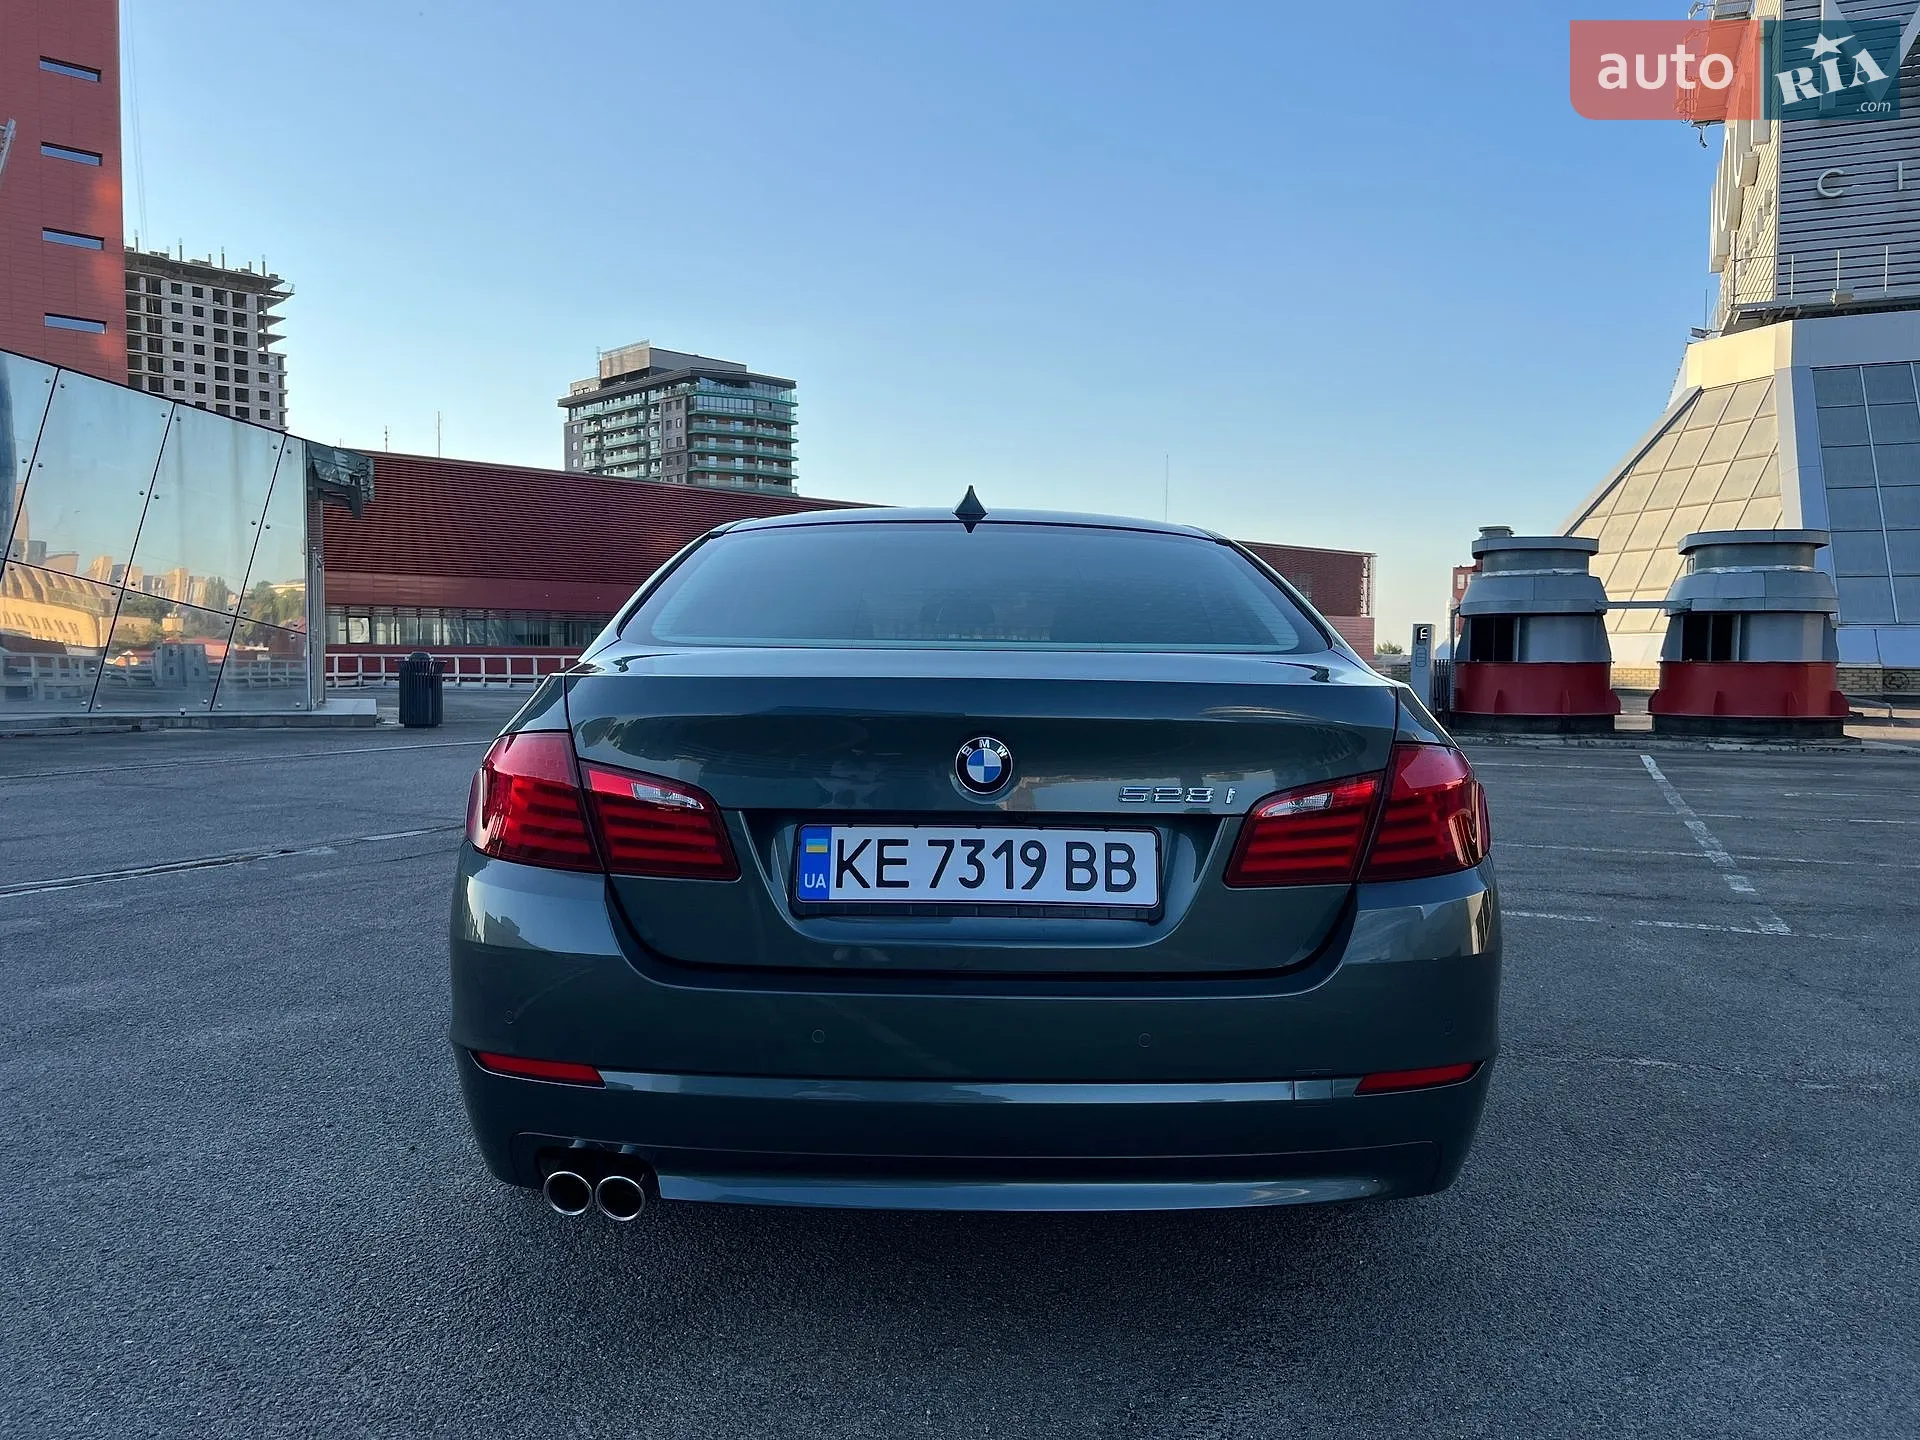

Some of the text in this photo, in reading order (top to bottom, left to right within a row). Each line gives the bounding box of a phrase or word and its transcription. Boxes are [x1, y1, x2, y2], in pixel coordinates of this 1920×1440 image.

[961, 739, 1008, 758] BMW
[835, 838, 1137, 893] KE 7319 BB
[804, 873, 827, 889] UA
